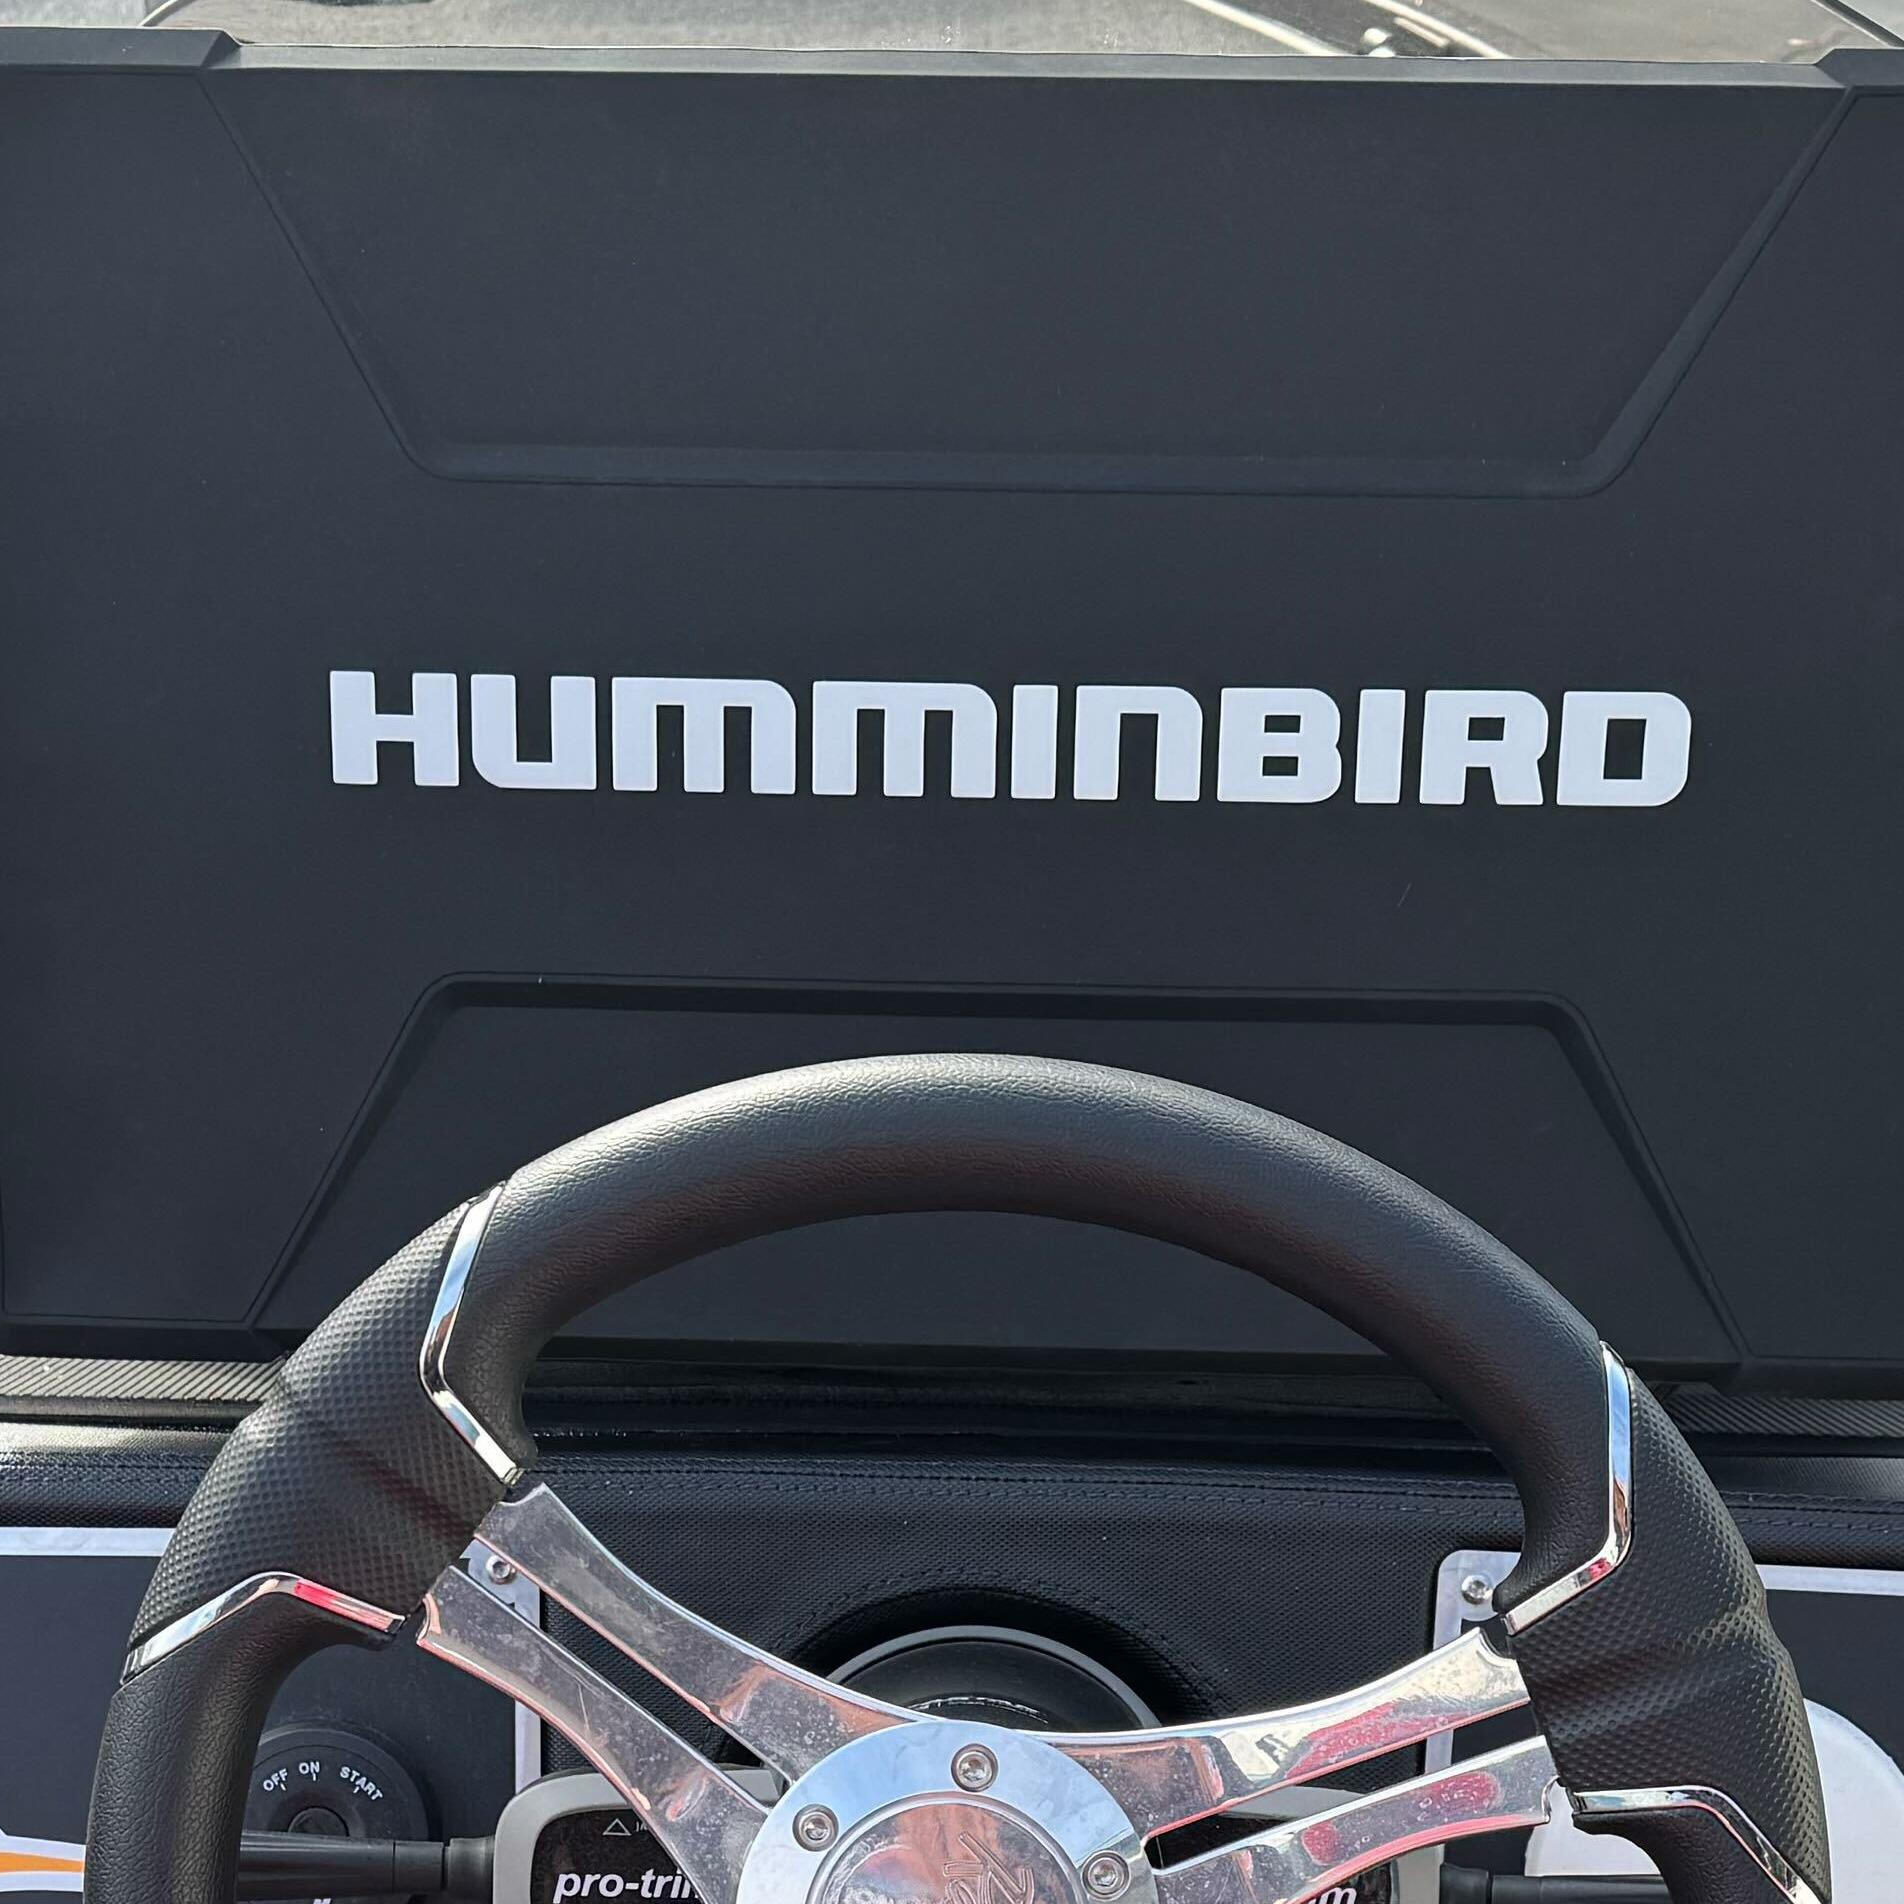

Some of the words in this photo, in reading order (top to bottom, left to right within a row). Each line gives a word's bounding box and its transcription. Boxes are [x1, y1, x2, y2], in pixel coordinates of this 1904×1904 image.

[329, 670, 1692, 806] HUMMINBIRD
[262, 1767, 289, 1792] OFF
[298, 1760, 321, 1776] ON
[339, 1766, 384, 1802] START
